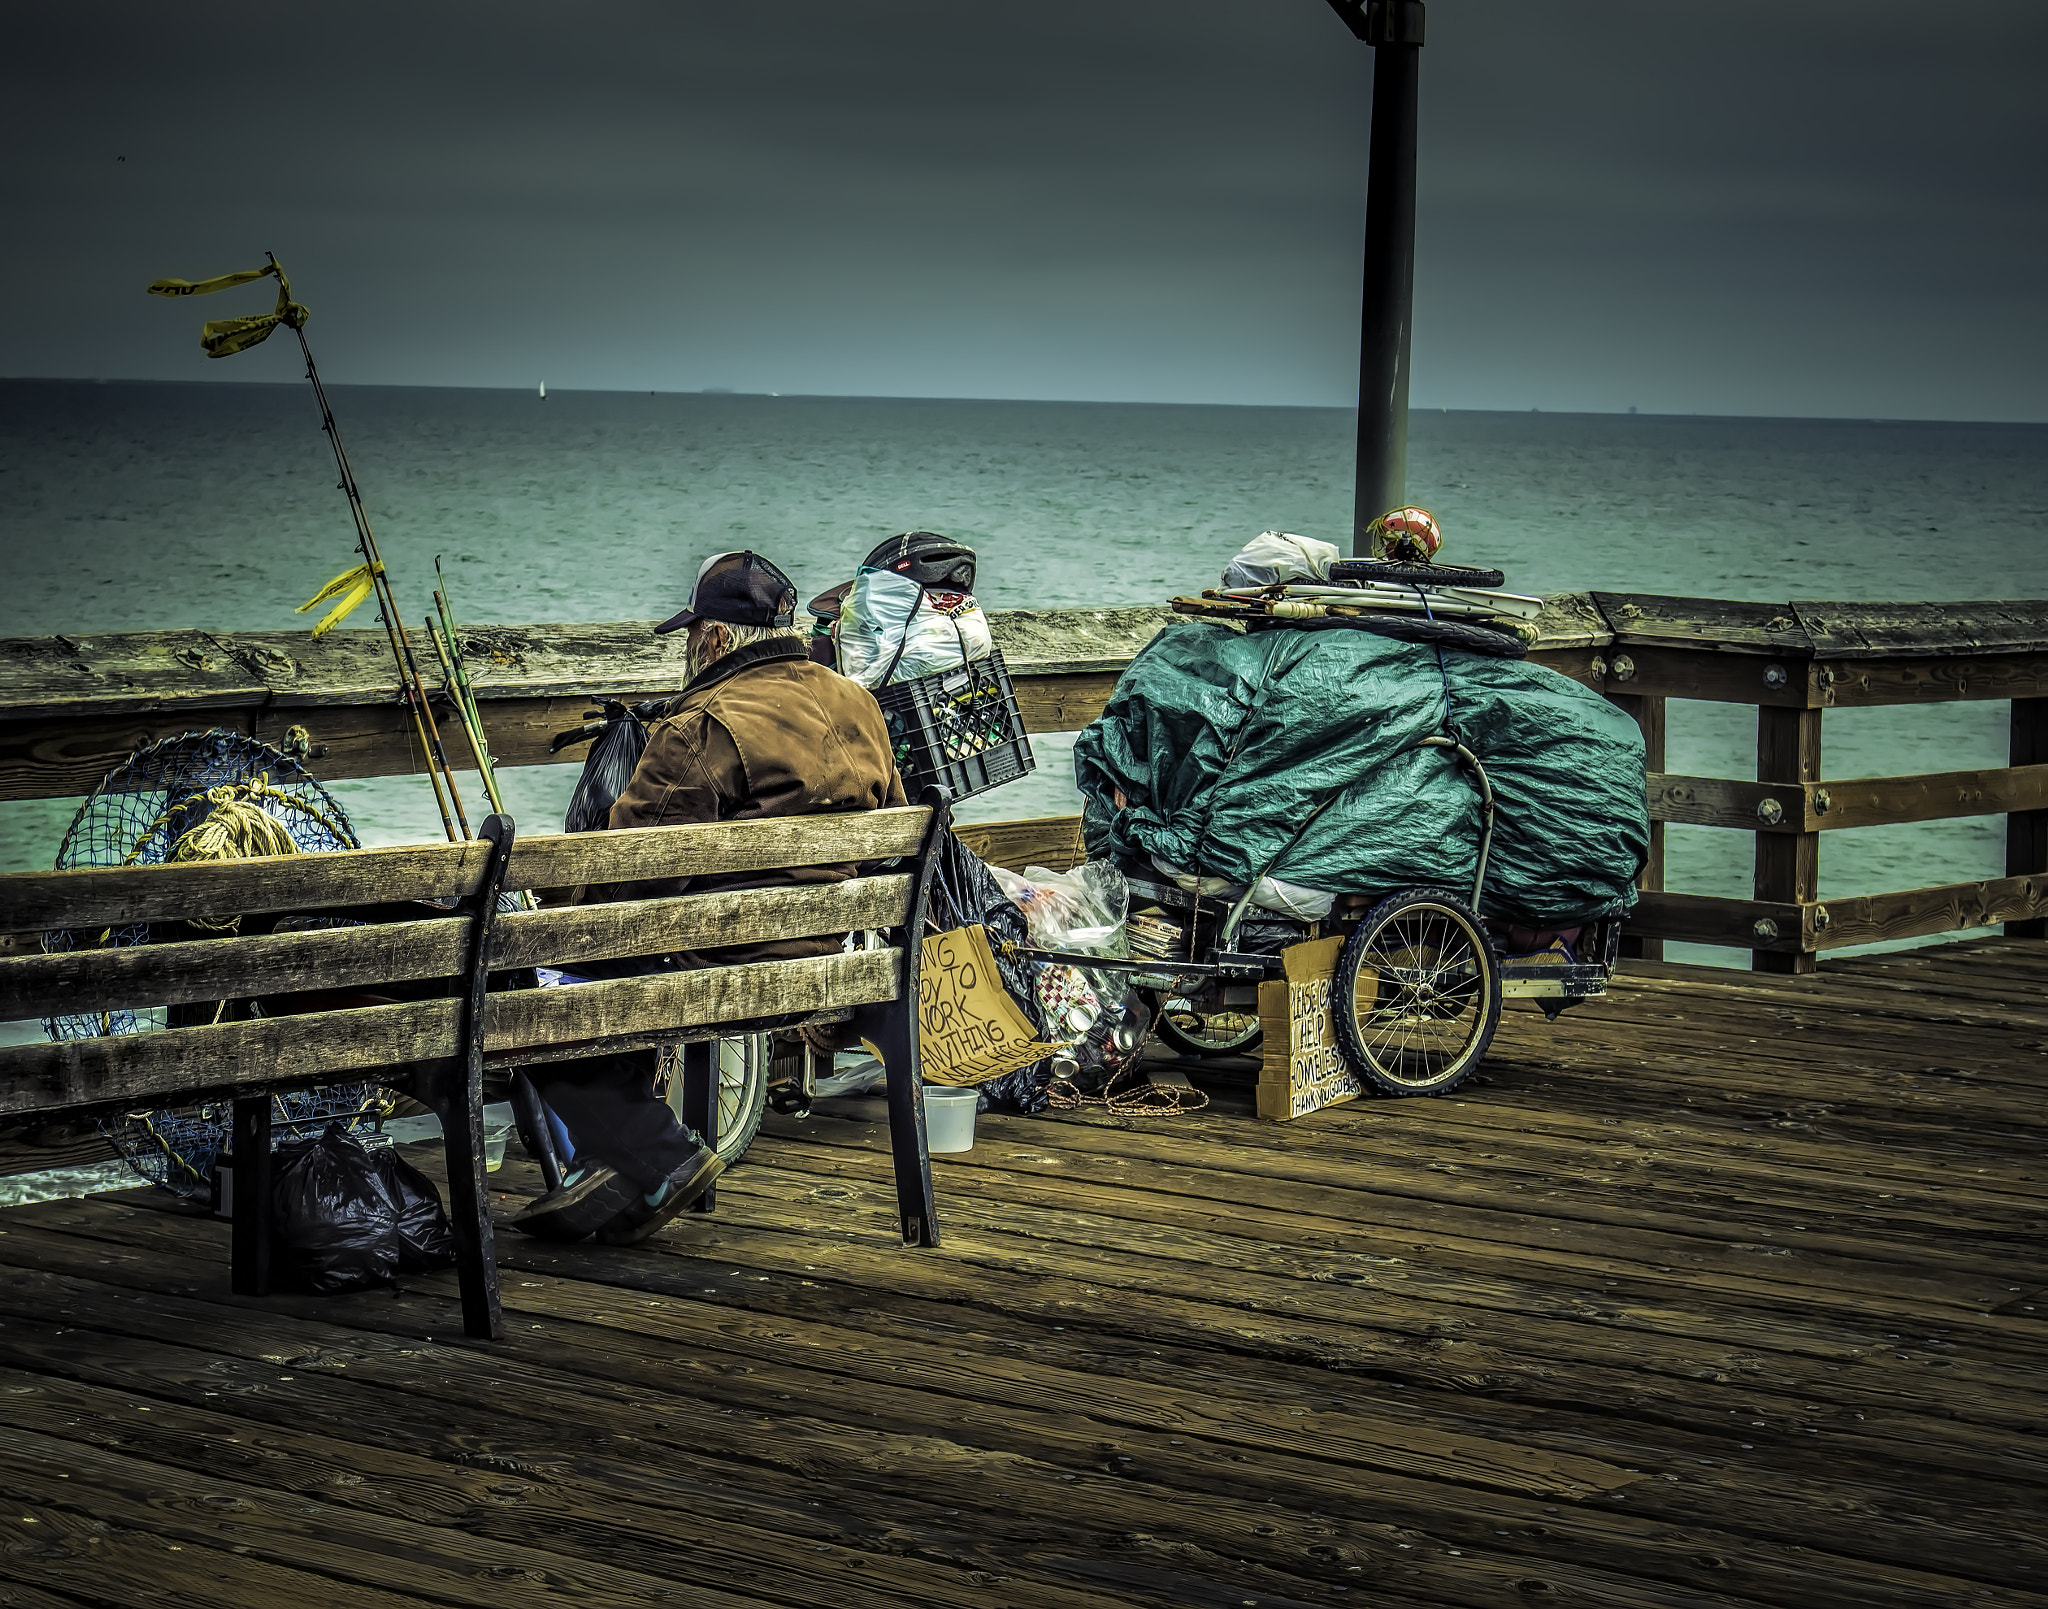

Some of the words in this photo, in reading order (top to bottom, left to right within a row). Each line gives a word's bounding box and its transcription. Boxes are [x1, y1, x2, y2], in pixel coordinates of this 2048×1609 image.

[920, 936, 956, 971] NG
[919, 976, 943, 1020] DY
[942, 962, 977, 997] TO
[1319, 979, 1334, 1010] CA
[920, 1020, 1005, 1075] ANYTHING
[1300, 1012, 1325, 1050] HELP
[984, 1038, 1036, 1063] HELP
[1291, 1045, 1347, 1092] HOMELESS
[1291, 1091, 1317, 1117] THANK
